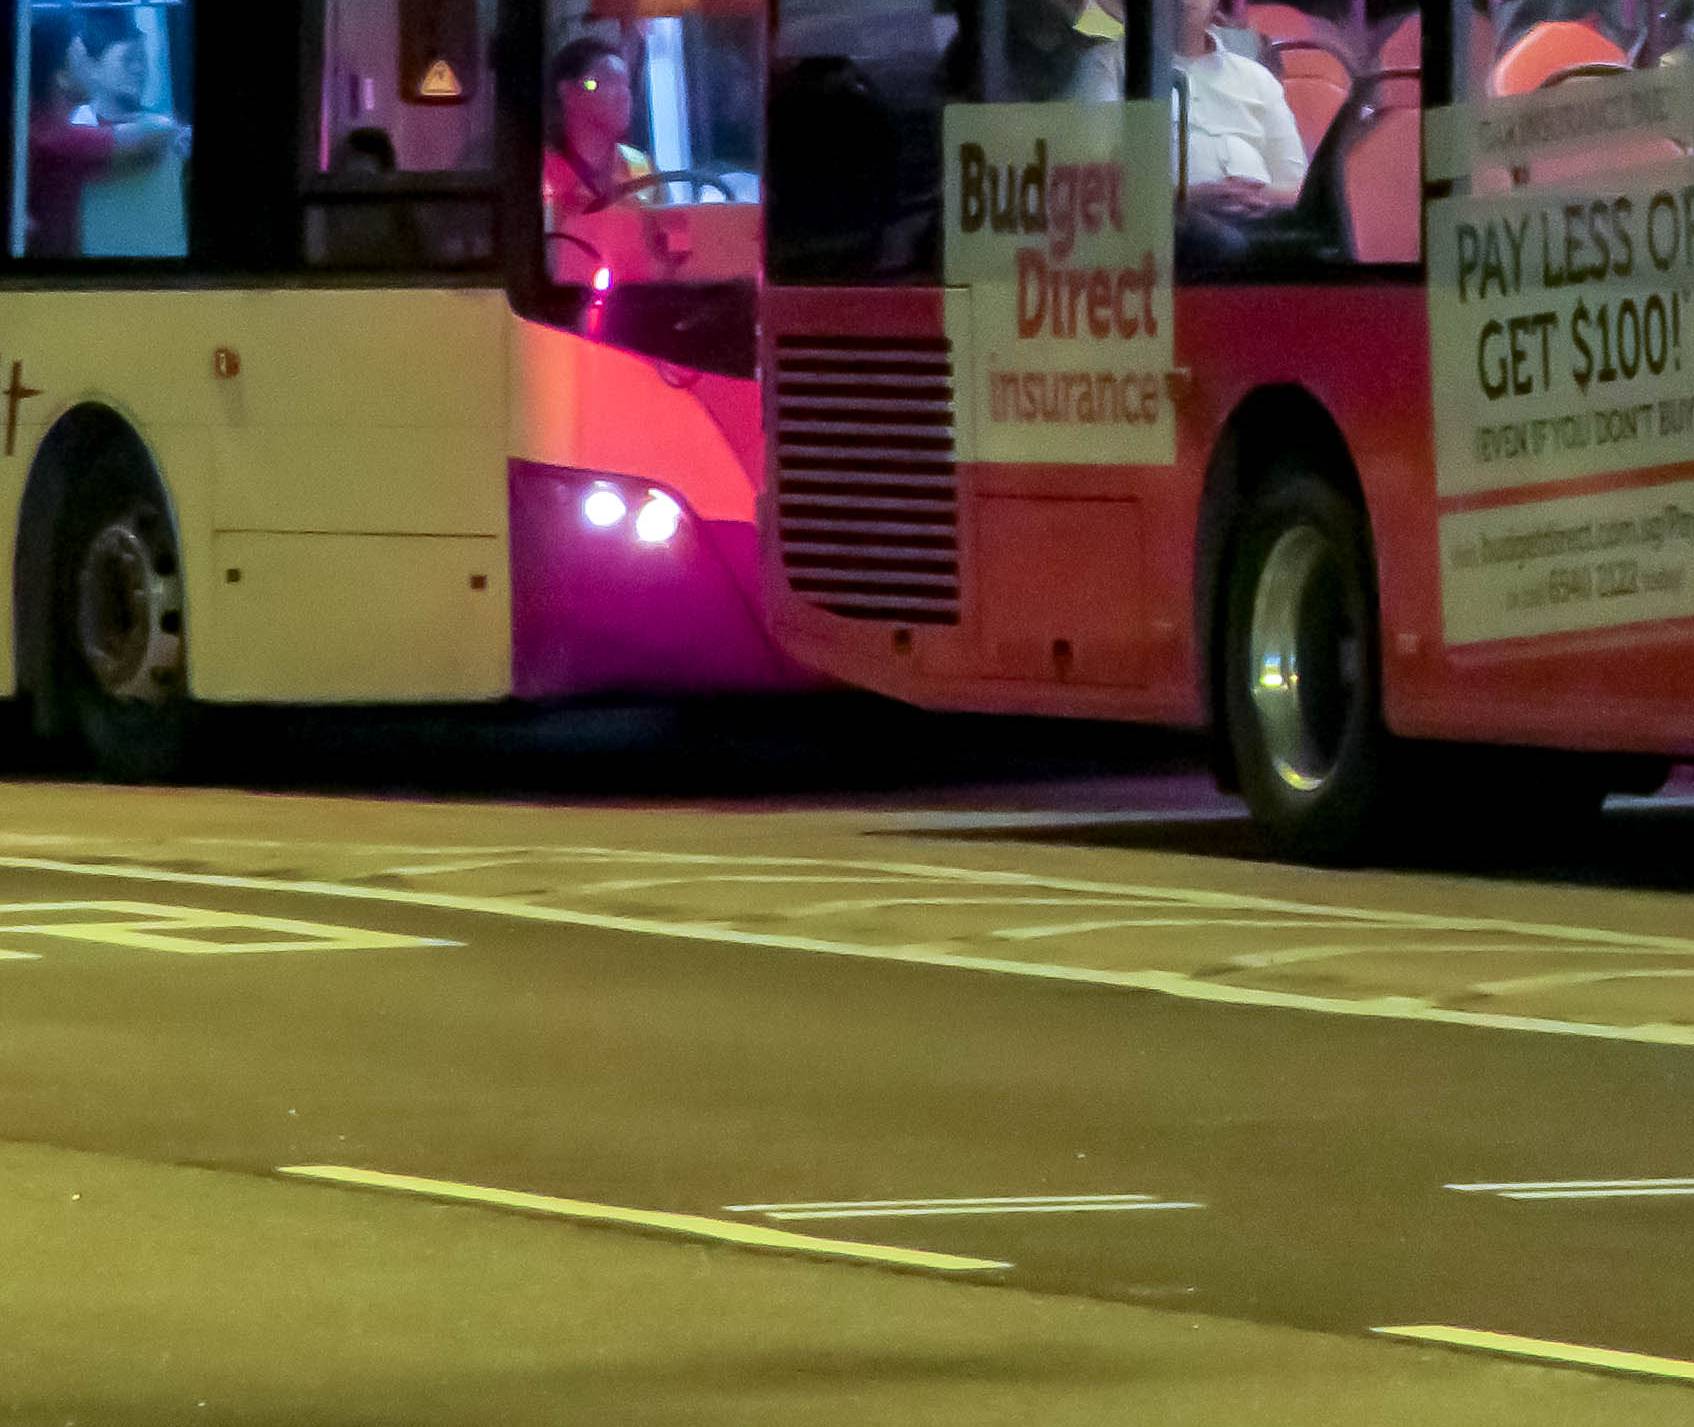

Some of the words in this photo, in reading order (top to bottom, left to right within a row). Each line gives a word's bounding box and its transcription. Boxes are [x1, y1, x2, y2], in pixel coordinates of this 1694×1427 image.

[958, 137, 1126, 262] Budget
[1015, 247, 1160, 340] Direct
[1456, 213, 1531, 303] PAY
[1542, 195, 1635, 288] LESS
[988, 352, 1159, 425] insurance
[1478, 311, 1560, 401] GET
